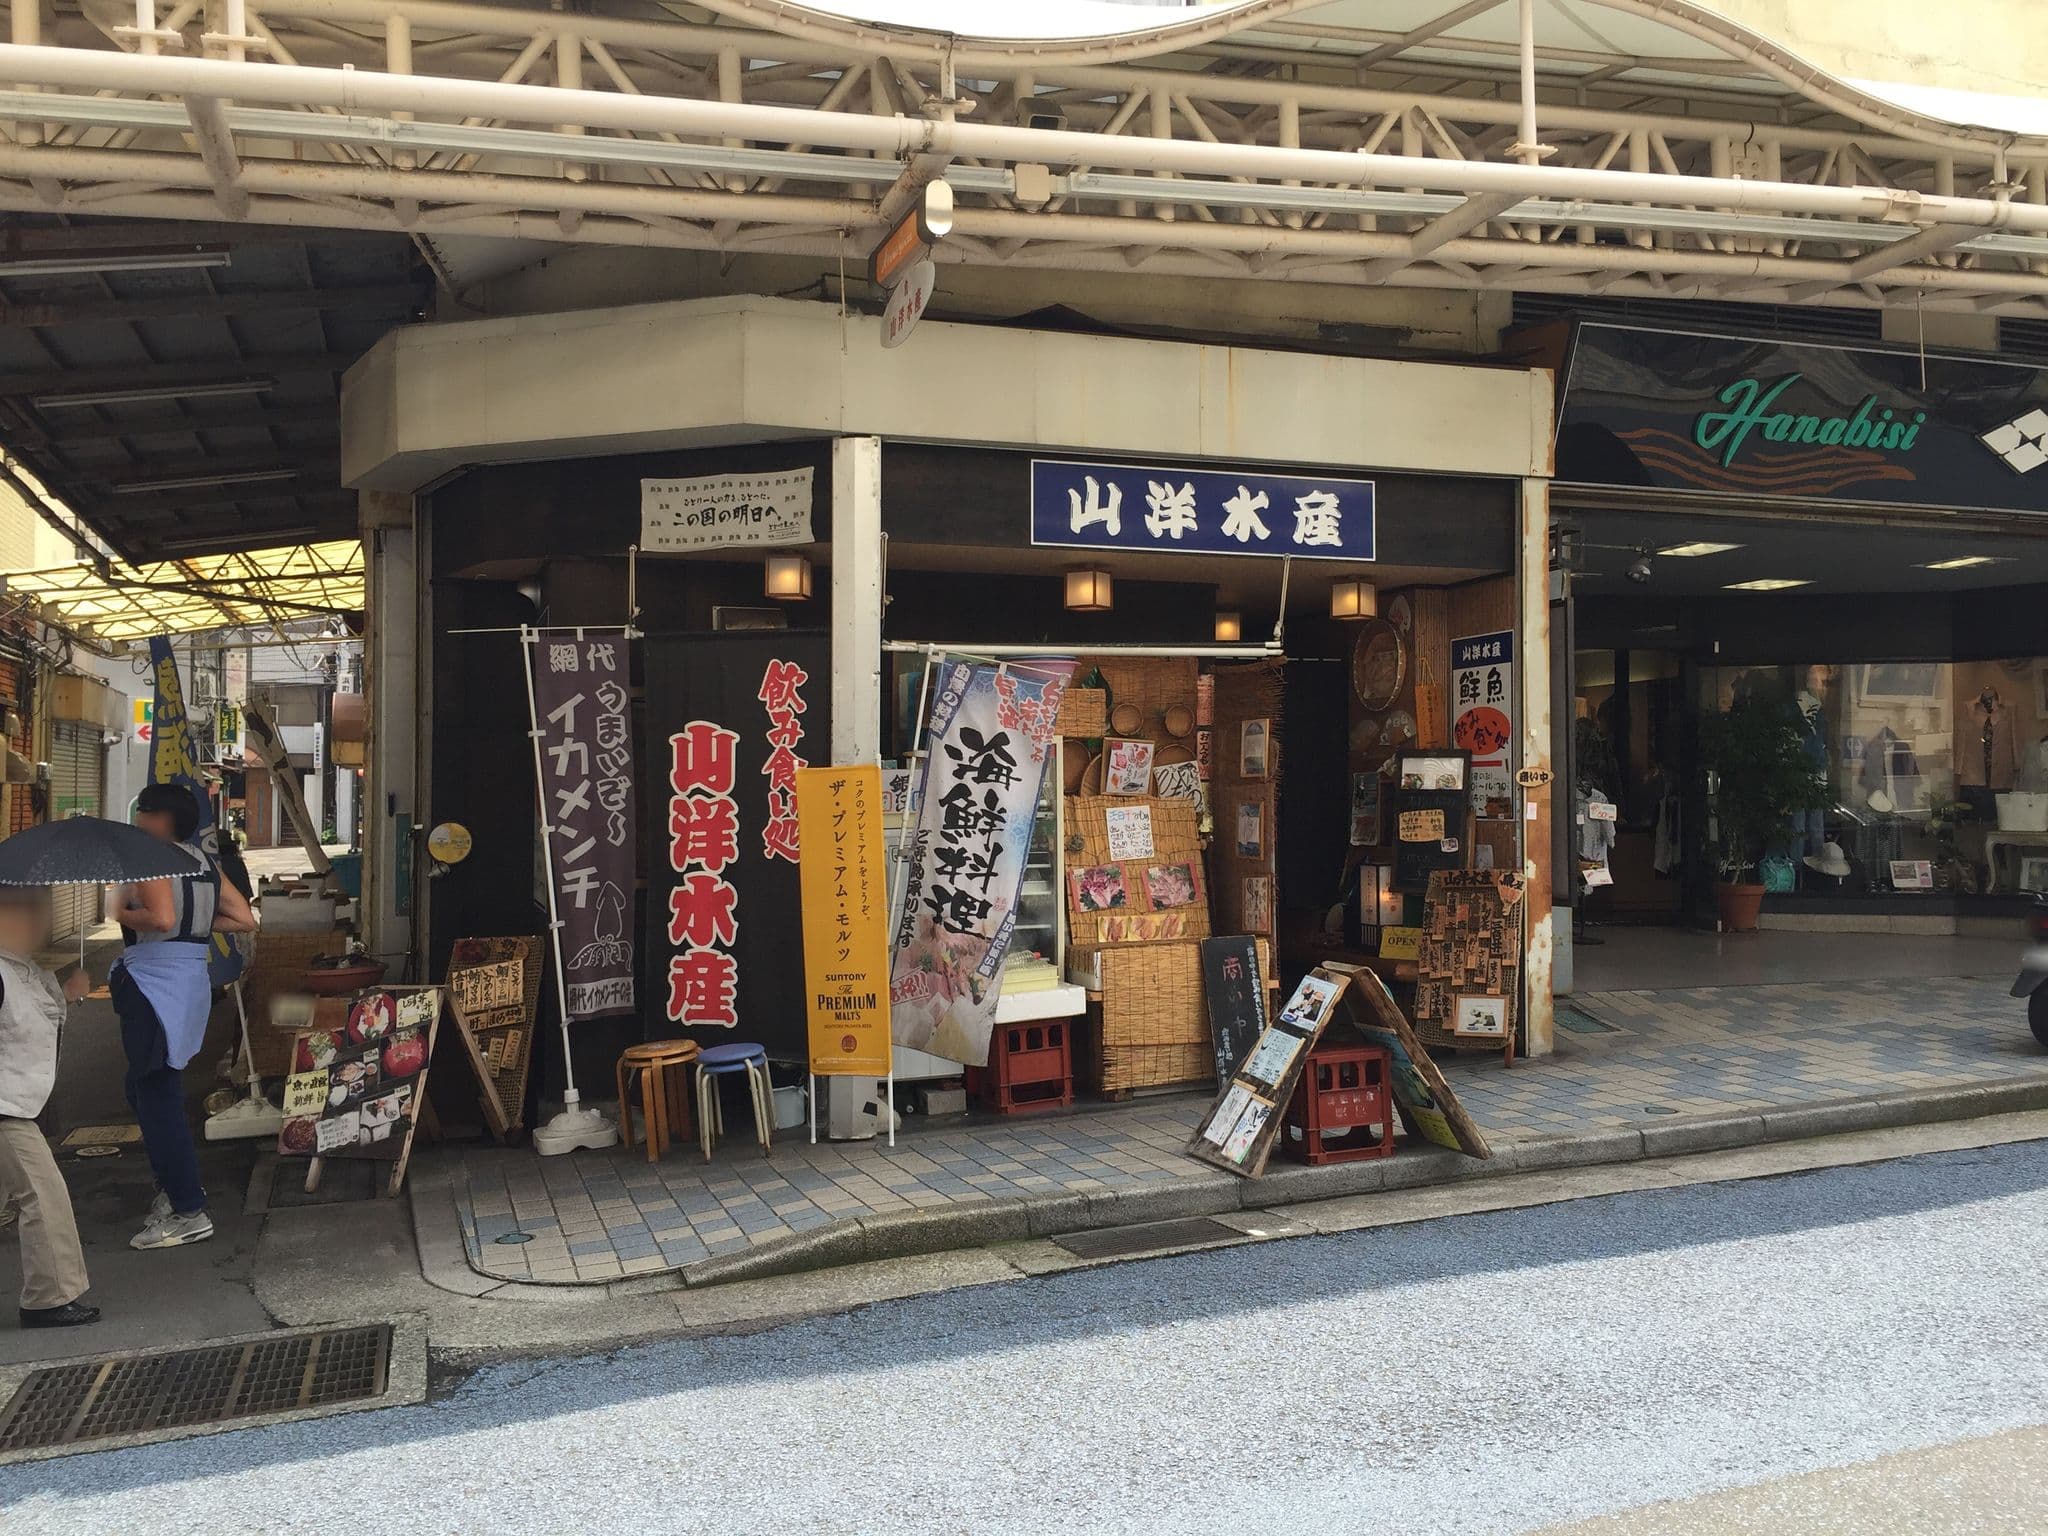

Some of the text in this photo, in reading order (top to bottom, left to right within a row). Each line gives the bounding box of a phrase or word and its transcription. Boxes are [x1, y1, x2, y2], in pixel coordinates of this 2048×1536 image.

[1696, 372, 1927, 468] Hanabisi
[1066, 475, 1344, 548] 山洋水産
[549, 643, 616, 673] 網代
[1461, 641, 1502, 663] 山洋水産
[1458, 666, 1505, 705] 鮮魚
[757, 658, 809, 863] 飲み食い処
[547, 692, 601, 909] イカメンチ
[924, 727, 1023, 942] 海鮮料理
[667, 720, 741, 1028] 山洋水産
[828, 779, 852, 963] ザ・プレミアム・モルツ
[898, 829, 933, 948] ご予約承ります
[1387, 936, 1417, 947] OPEN
[817, 993, 877, 1011] PREMIUM
[825, 973, 867, 982] SUNTORY
[837, 984, 854, 995] The
[834, 1010, 861, 1021] MALT'S
